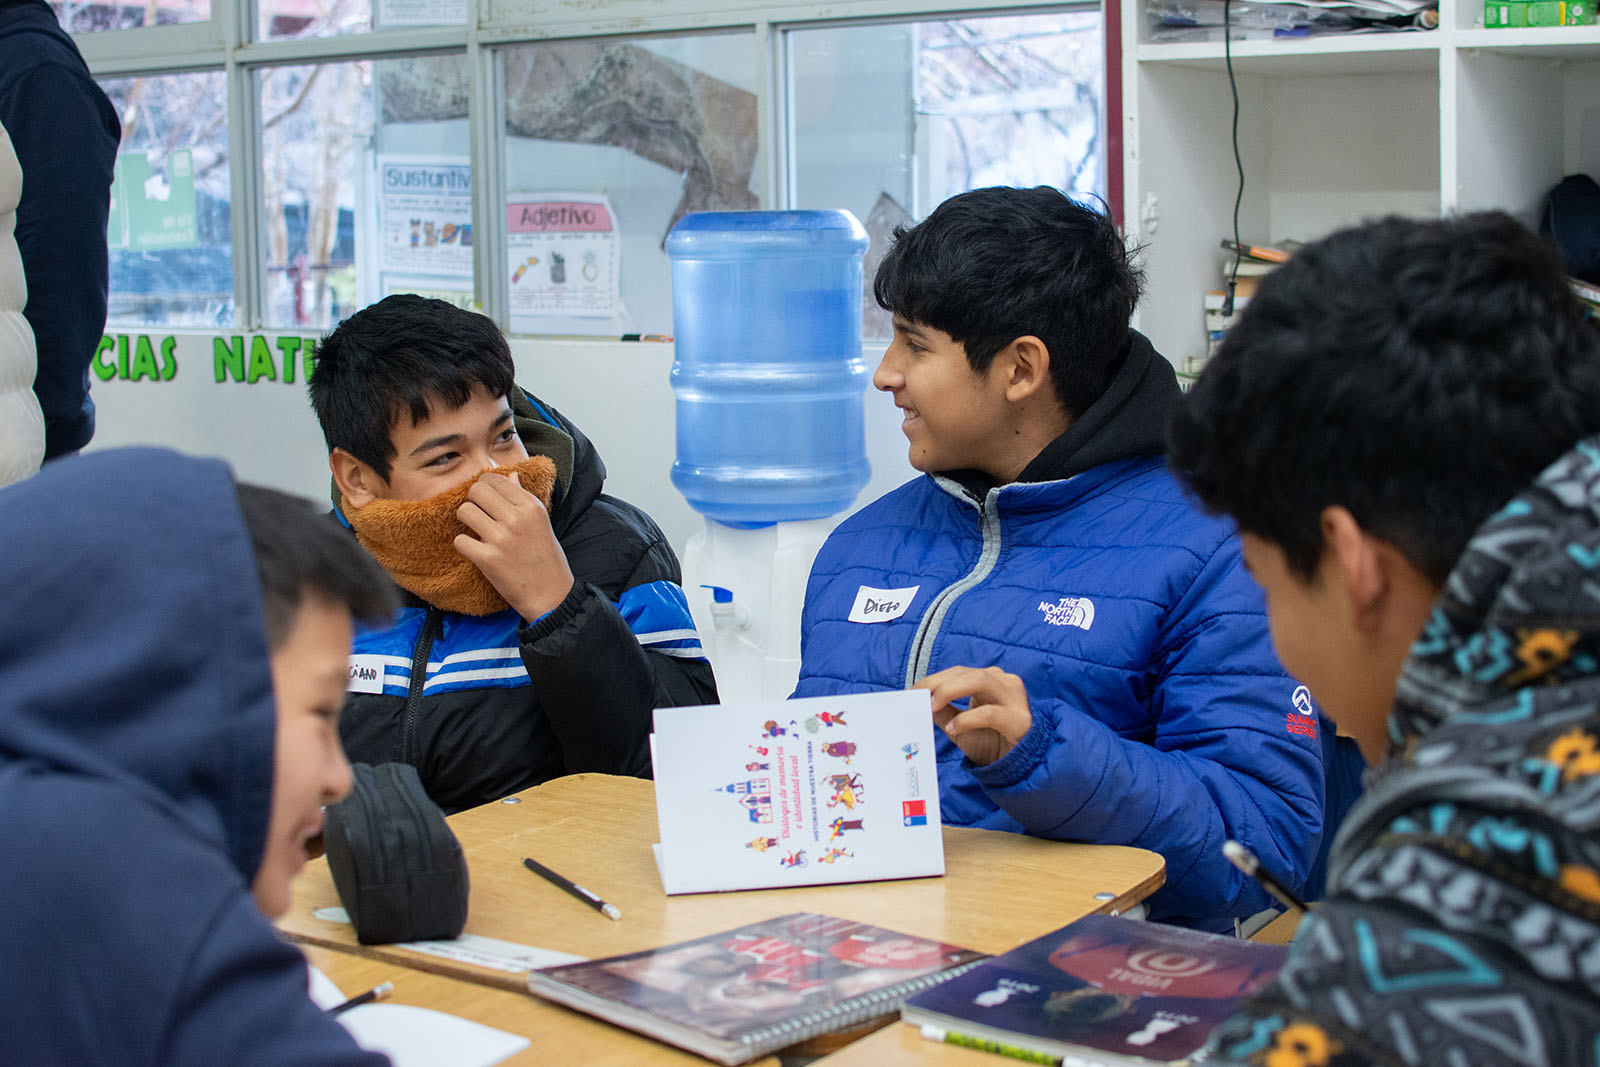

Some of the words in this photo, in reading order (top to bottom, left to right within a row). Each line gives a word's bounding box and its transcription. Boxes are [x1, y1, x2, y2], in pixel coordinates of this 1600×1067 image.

[520, 206, 595, 230] Adjetivo
[1037, 601, 1075, 616] NORTH
[1059, 598, 1078, 608] THE
[1044, 613, 1070, 626] FACE
[806, 741, 814, 763] TIERRA
[776, 746, 786, 786] memoria
[789, 755, 799, 777] local
[808, 765, 816, 795] NUESTRA
[779, 788, 788, 799] de
[791, 779, 802, 822] identidad
[810, 796, 817, 806] DE
[781, 800, 791, 839] Diálogos
[811, 807, 819, 842] HISTORIAS
